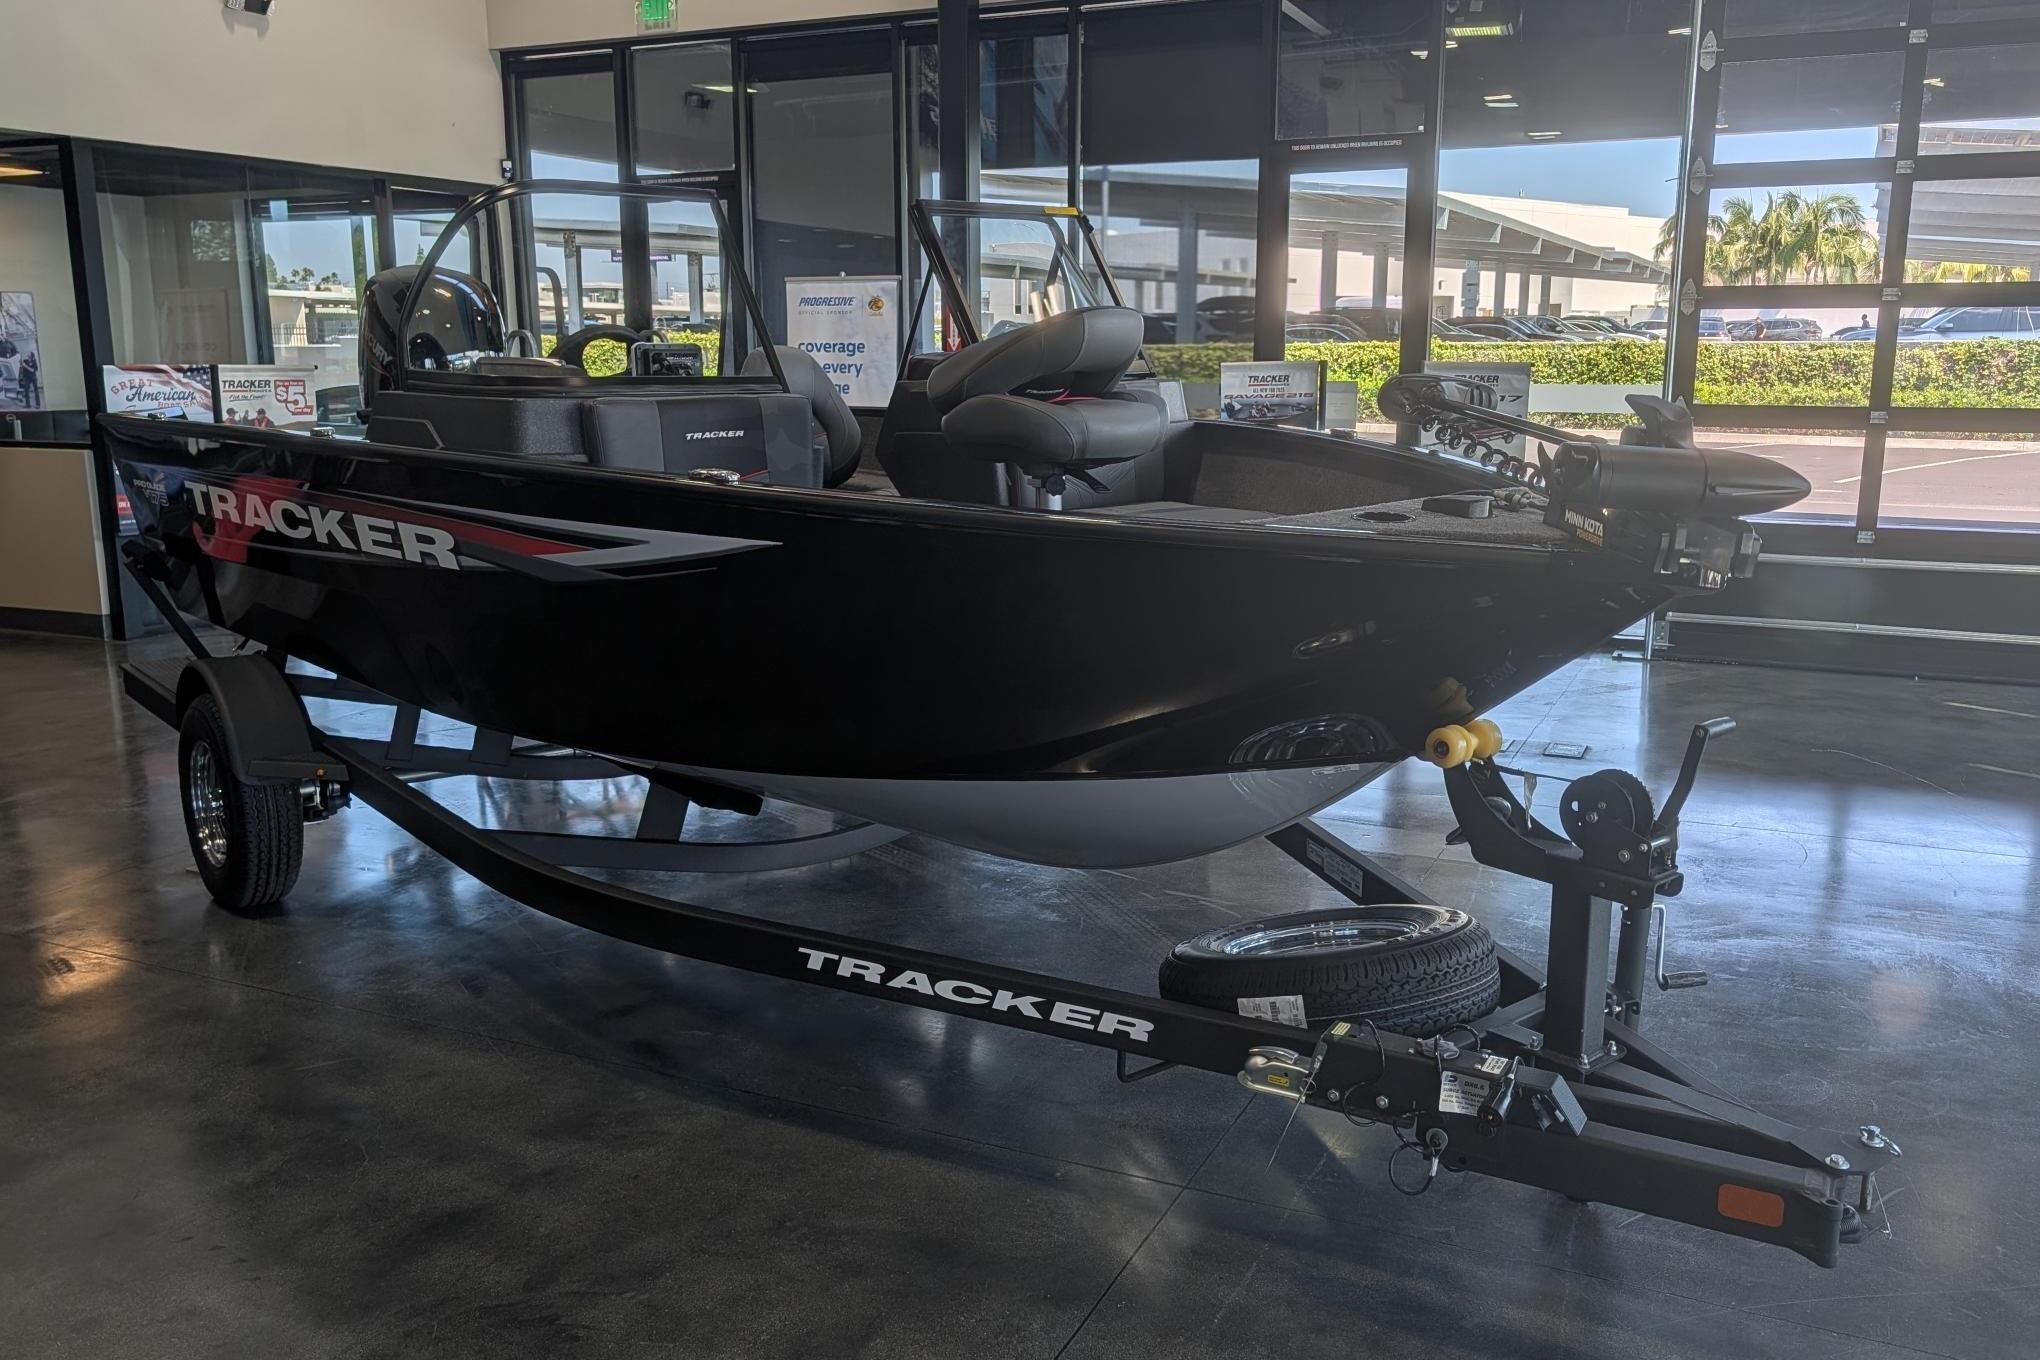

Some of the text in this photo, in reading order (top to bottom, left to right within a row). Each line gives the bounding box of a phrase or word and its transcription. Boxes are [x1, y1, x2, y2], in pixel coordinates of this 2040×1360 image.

[798, 296, 856, 307] PROGRESSIVE
[822, 362, 863, 378] every
[110, 379, 153, 394] GREAT
[222, 380, 271, 389] TRACKER
[1248, 374, 1290, 384] TRACKER
[126, 384, 196, 402] American
[276, 386, 306, 413] $5
[685, 430, 744, 440] TRACKER
[184, 480, 460, 571] TRACKER
[1564, 509, 1603, 536] MINN KOTA
[798, 947, 1154, 1042] TRACKER
